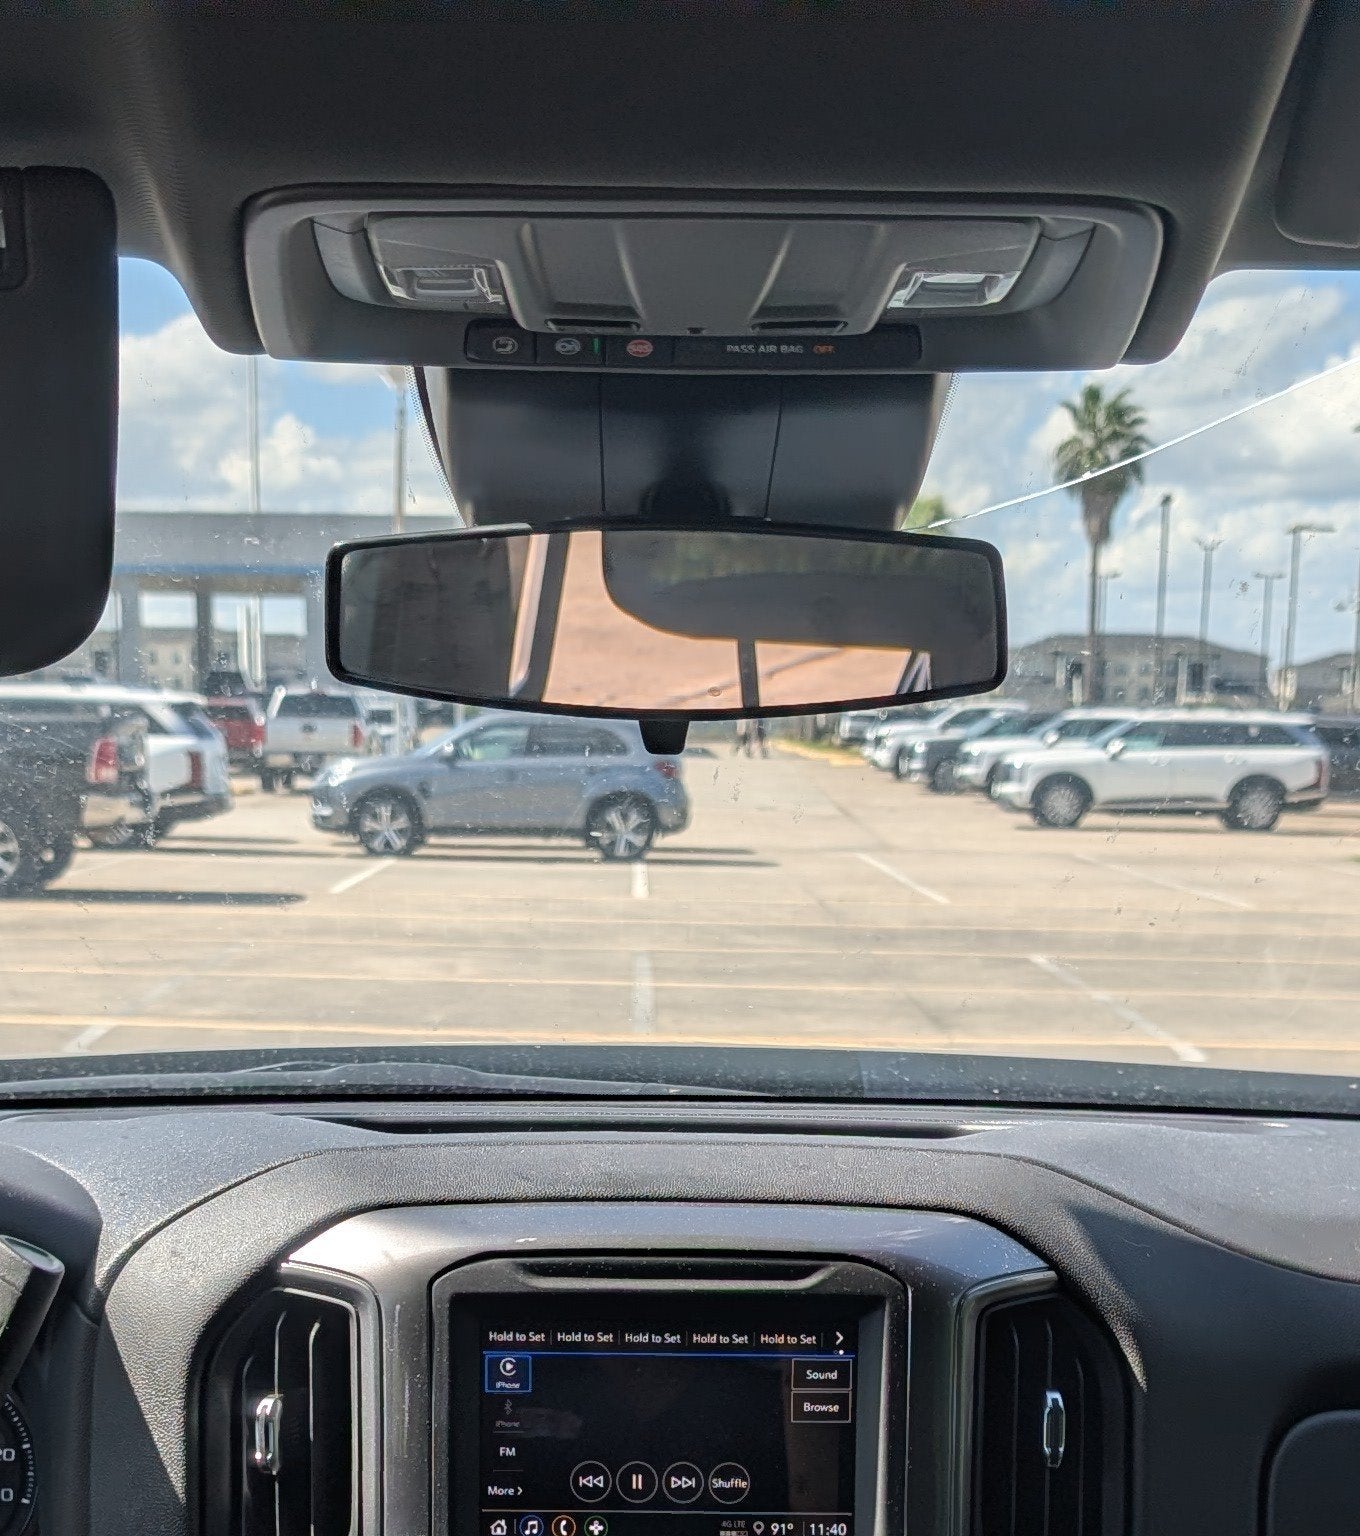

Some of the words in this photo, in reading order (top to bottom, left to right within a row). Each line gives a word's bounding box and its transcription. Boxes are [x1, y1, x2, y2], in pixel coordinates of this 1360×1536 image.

[726, 344, 755, 353] PASS
[758, 345, 778, 354] AIR
[780, 345, 803, 354] BAG
[489, 1331, 514, 1342] Hold
[515, 1332, 527, 1342] to
[528, 1331, 546, 1342] Set
[557, 1332, 582, 1342] Hold
[583, 1333, 595, 1342] to
[597, 1332, 614, 1343] Set
[625, 1332, 649, 1343] Hold
[651, 1333, 662, 1343] to
[664, 1332, 681, 1344] Set
[692, 1333, 717, 1344] Hold
[719, 1334, 730, 1344] to
[731, 1333, 749, 1344] Set
[760, 1333, 785, 1344] Hold
[786, 1334, 798, 1344] to
[800, 1334, 817, 1345] Set
[806, 1369, 838, 1380] Sound
[803, 1402, 840, 1413] Browse
[499, 1446, 516, 1457] FM
[711, 1478, 748, 1489] Shuffle
[487, 1485, 515, 1496] More
[721, 1520, 732, 1528] 4G
[809, 1522, 848, 1536] 11:40
